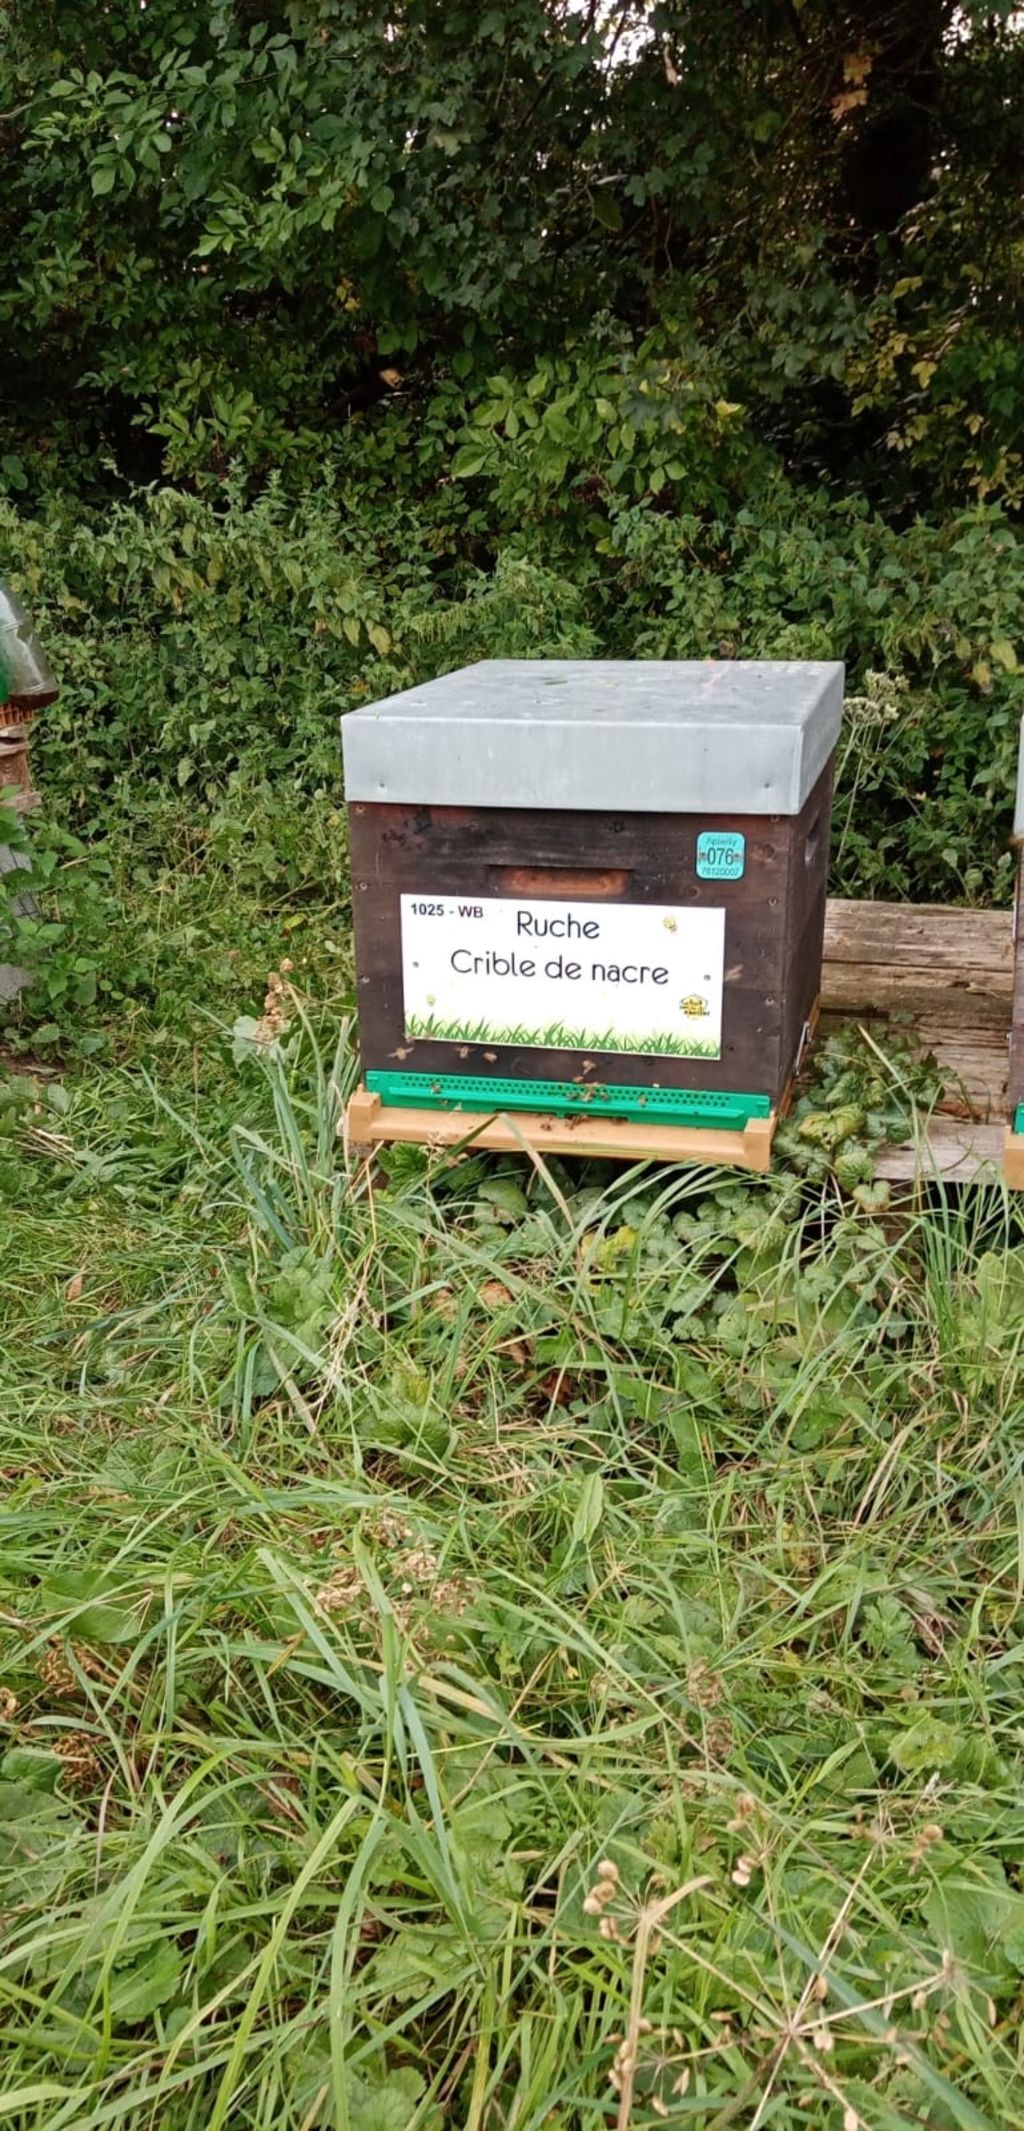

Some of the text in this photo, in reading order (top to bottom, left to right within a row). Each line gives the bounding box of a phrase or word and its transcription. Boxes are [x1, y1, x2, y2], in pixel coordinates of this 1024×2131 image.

[707, 847, 734, 865] 076
[410, 903, 445, 917] 1025
[457, 905, 484, 919] WB
[516, 910, 600, 940] Ruche
[450, 949, 669, 985] Crible de nacre
